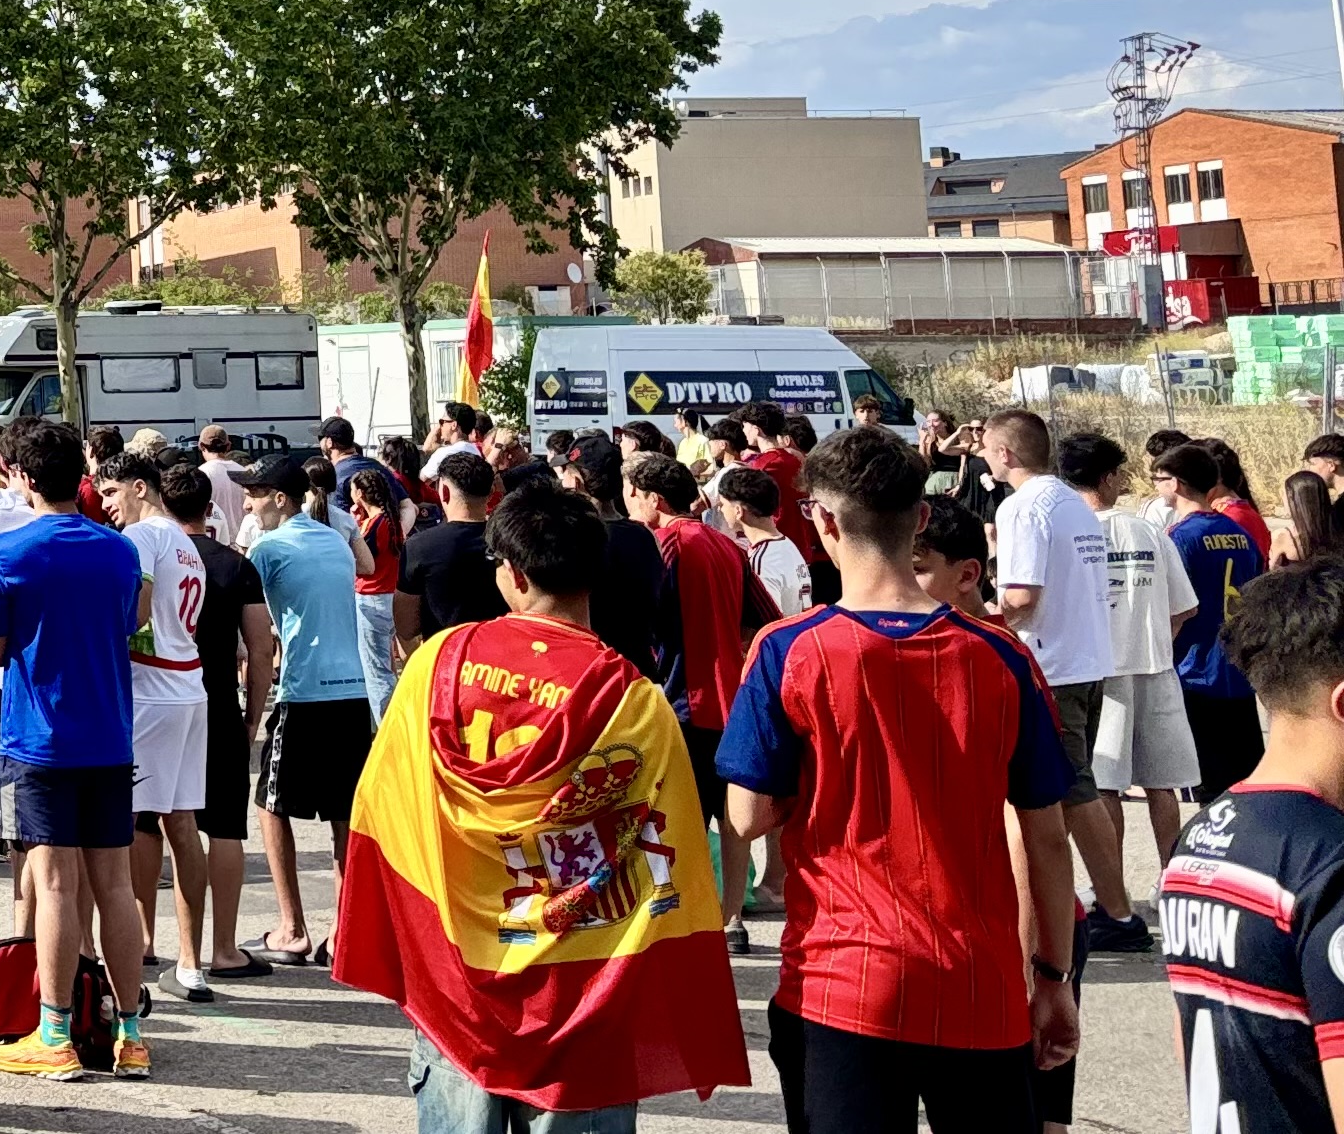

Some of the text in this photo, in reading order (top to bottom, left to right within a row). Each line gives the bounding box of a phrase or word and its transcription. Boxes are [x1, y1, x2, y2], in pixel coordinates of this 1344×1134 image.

[775, 374, 825, 387] DTPRO.ES
[665, 381, 752, 404] DTPRO
[534, 399, 568, 410] DTPRO
